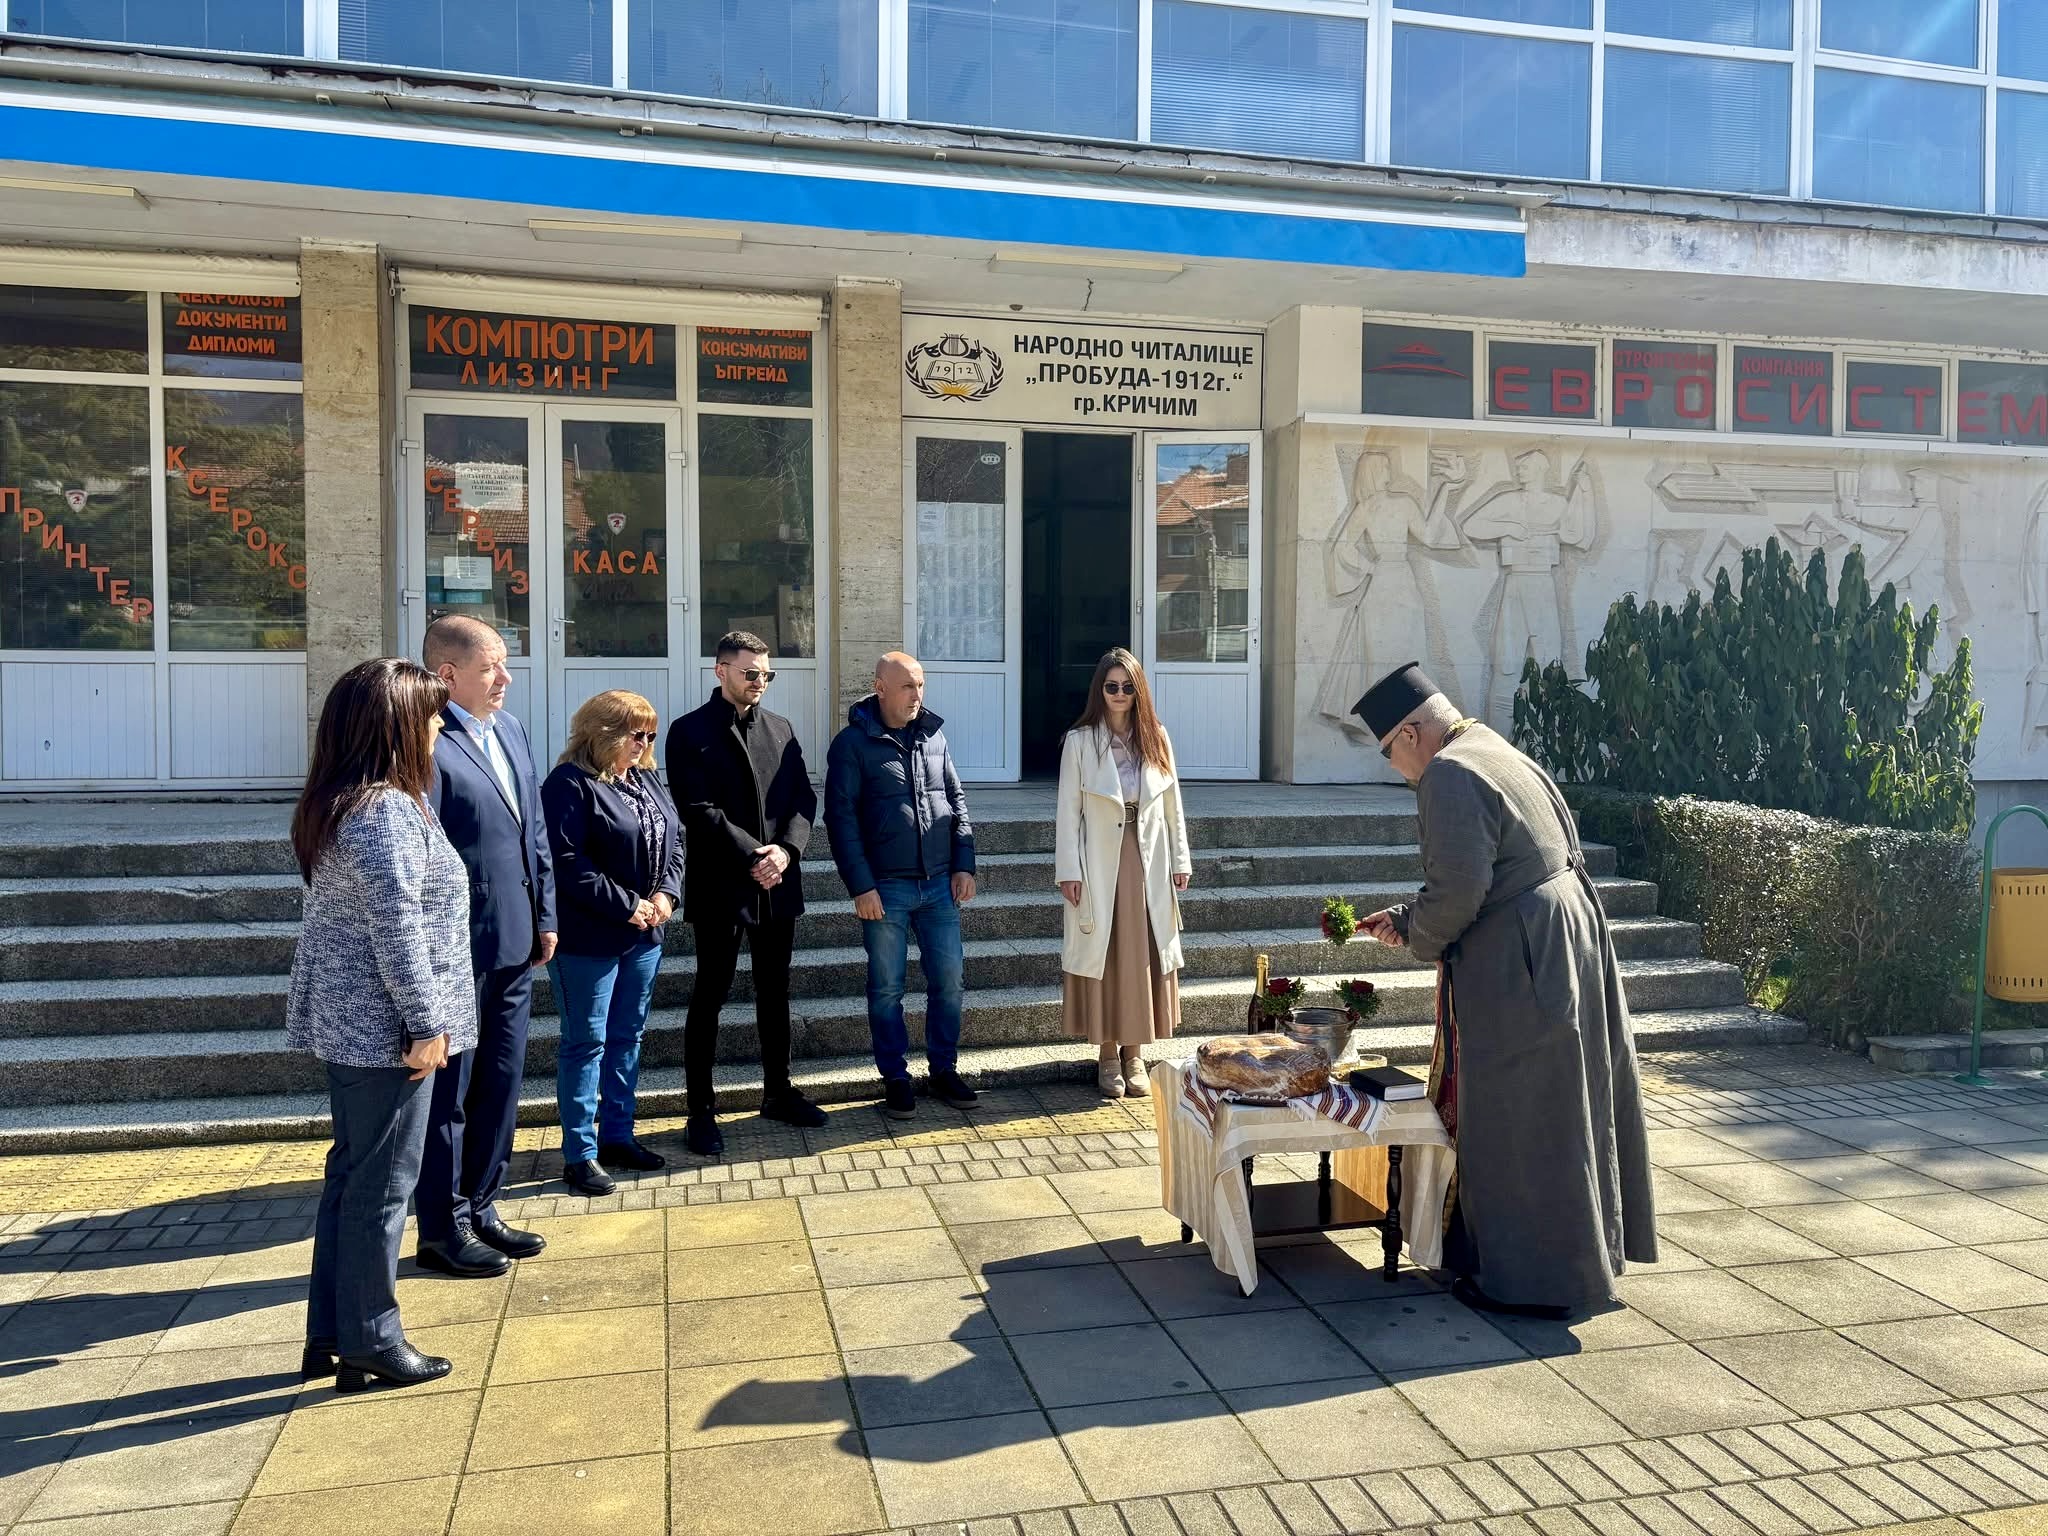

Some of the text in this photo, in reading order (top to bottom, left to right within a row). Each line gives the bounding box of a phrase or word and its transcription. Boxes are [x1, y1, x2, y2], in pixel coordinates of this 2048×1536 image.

[176, 310, 287, 331] ДОКУМЕНТИ
[187, 335, 276, 355] ДИПЛОМИ
[426, 314, 655, 366] КОМПЮТРИ
[701, 341, 808, 361] КОНСУМАТИВИ
[1014, 334, 1254, 368] НАРОДНО ЧИТАЛИЩЕ
[460, 360, 619, 391] ЛИЗИНГ
[715, 365, 788, 383] ЪПГРЕЙД
[1742, 357, 1825, 377] КОМПАНИЯ
[167, 446, 306, 589] КСЕРОКС
[425, 468, 530, 595] СЕРВИЗ
[0, 487, 153, 623] ПРИНТЕР
[573, 549, 660, 576] КАСА
